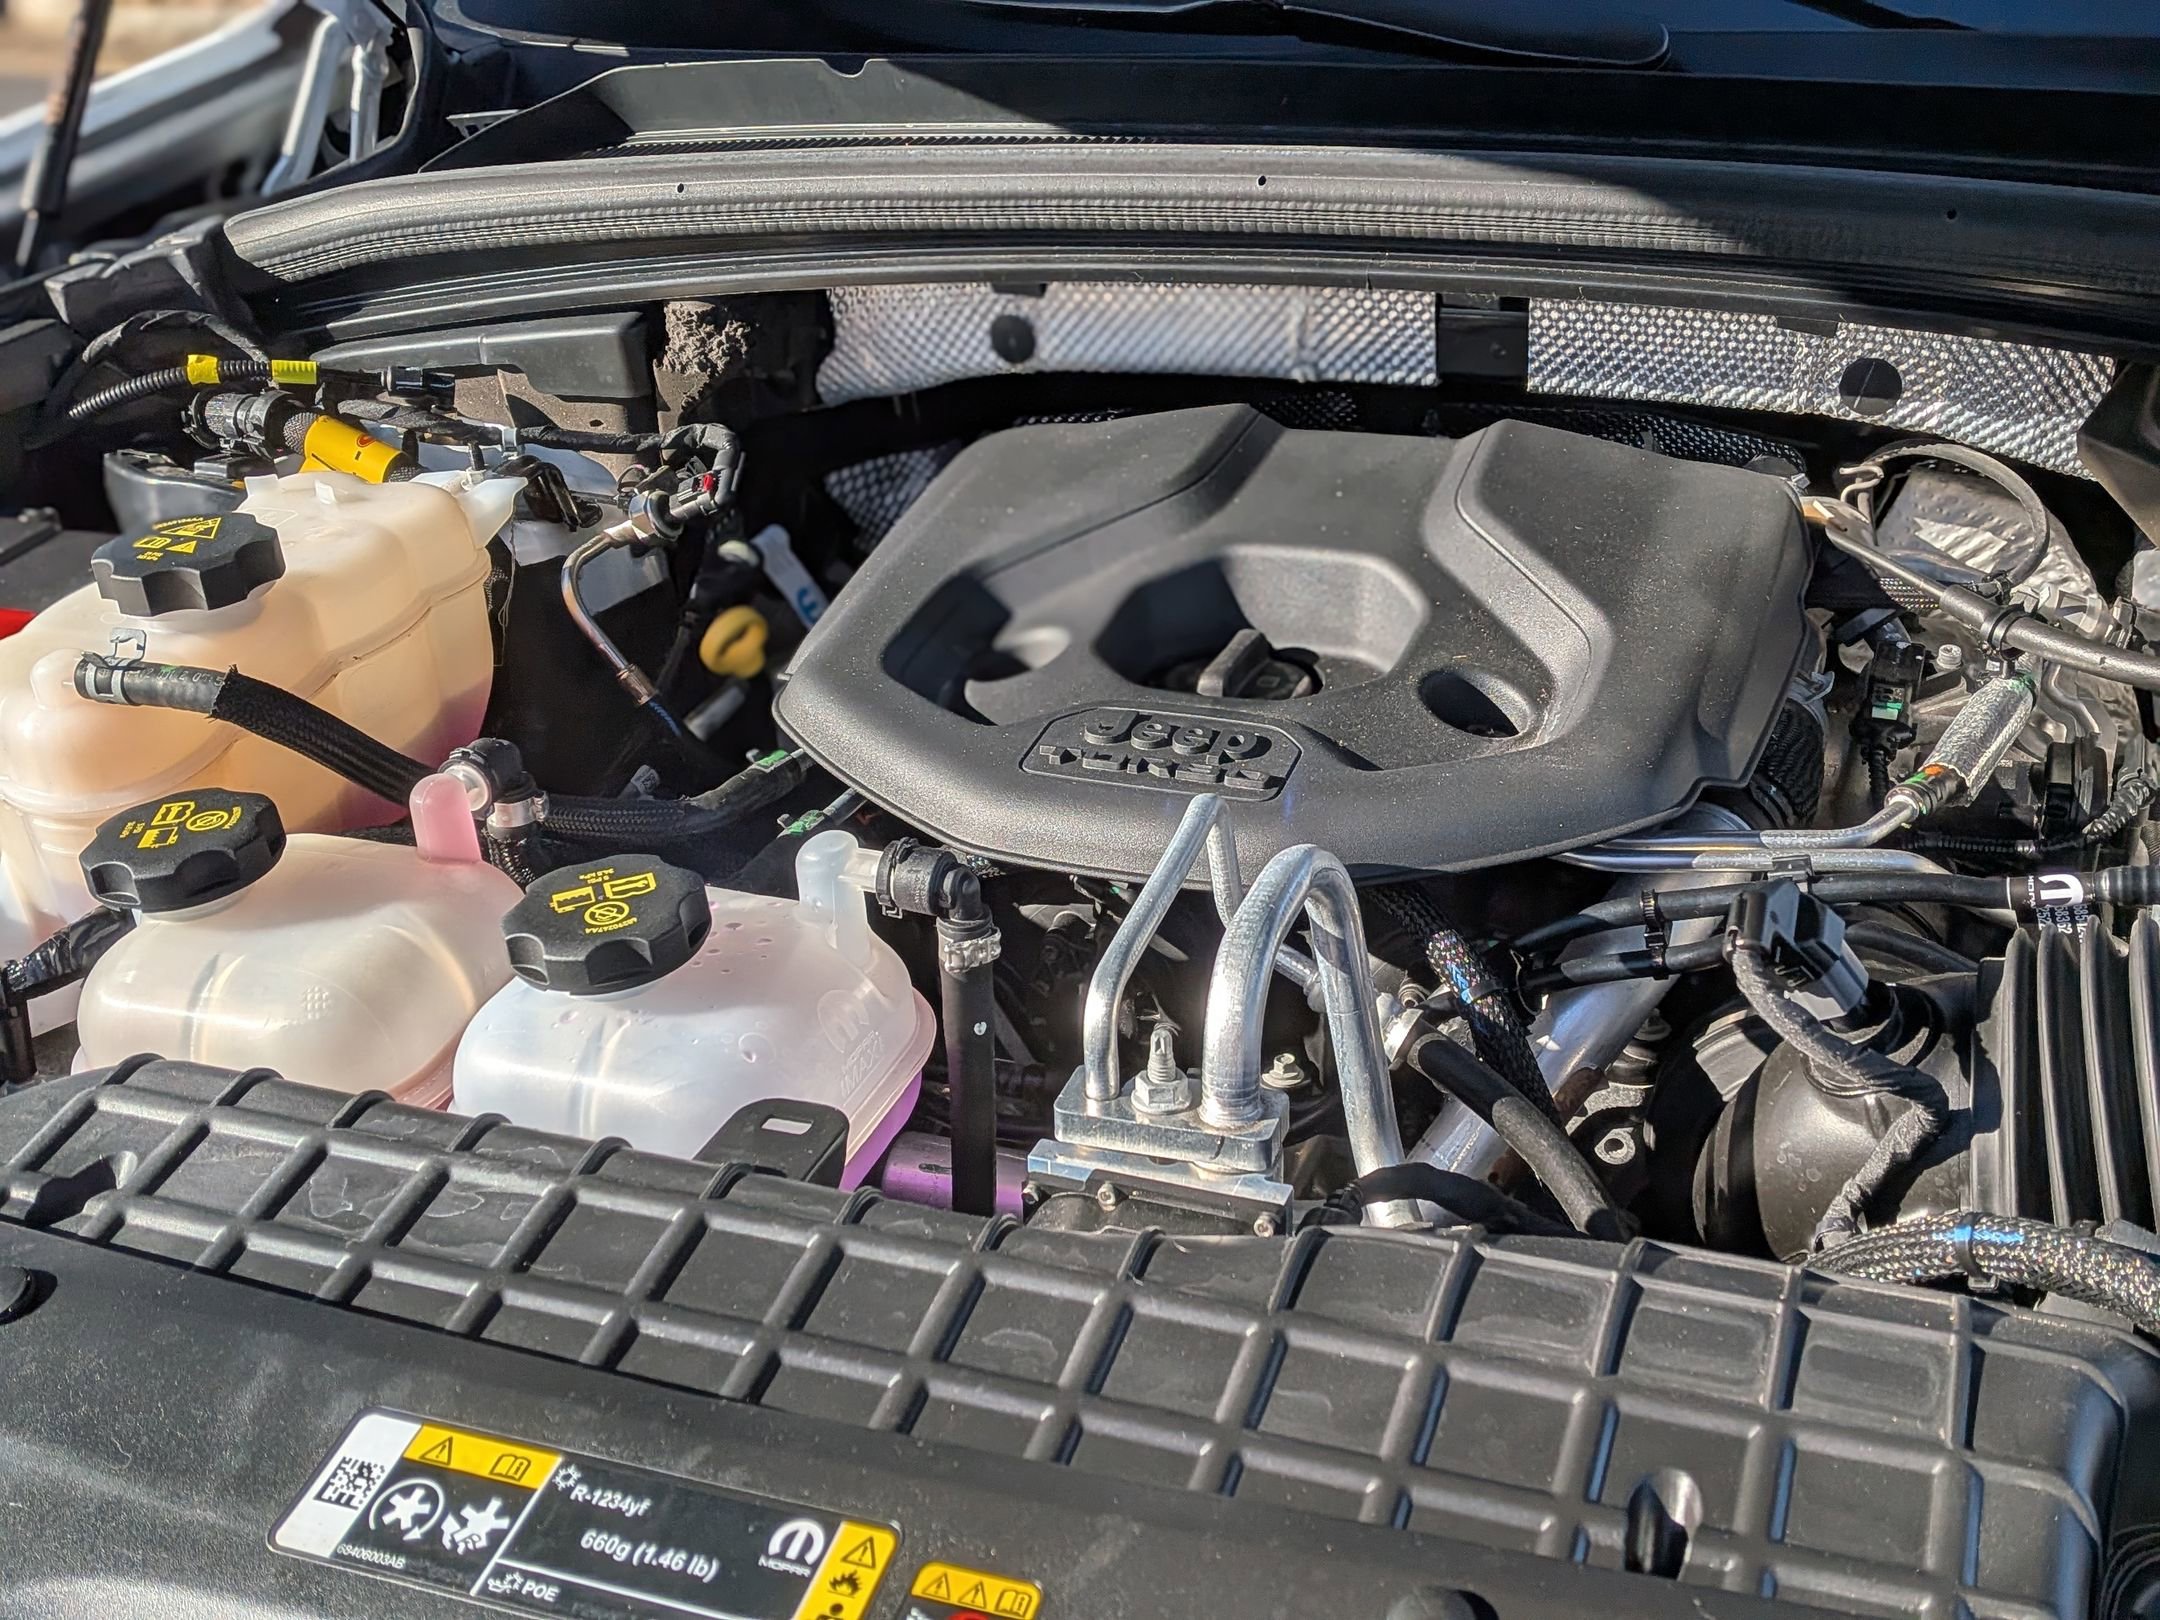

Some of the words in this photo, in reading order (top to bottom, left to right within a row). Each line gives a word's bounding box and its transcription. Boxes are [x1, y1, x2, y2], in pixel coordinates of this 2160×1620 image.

[1084, 710, 1258, 765] Jeep
[1039, 746, 1270, 791] TURBO
[569, 1483, 652, 1518] R-1234yf
[580, 1528, 632, 1562] 660g
[632, 1542, 688, 1572] (1.46
[686, 1553, 721, 1584] lb)
[758, 1554, 812, 1578] MOPAR
[521, 1580, 561, 1602] POE
